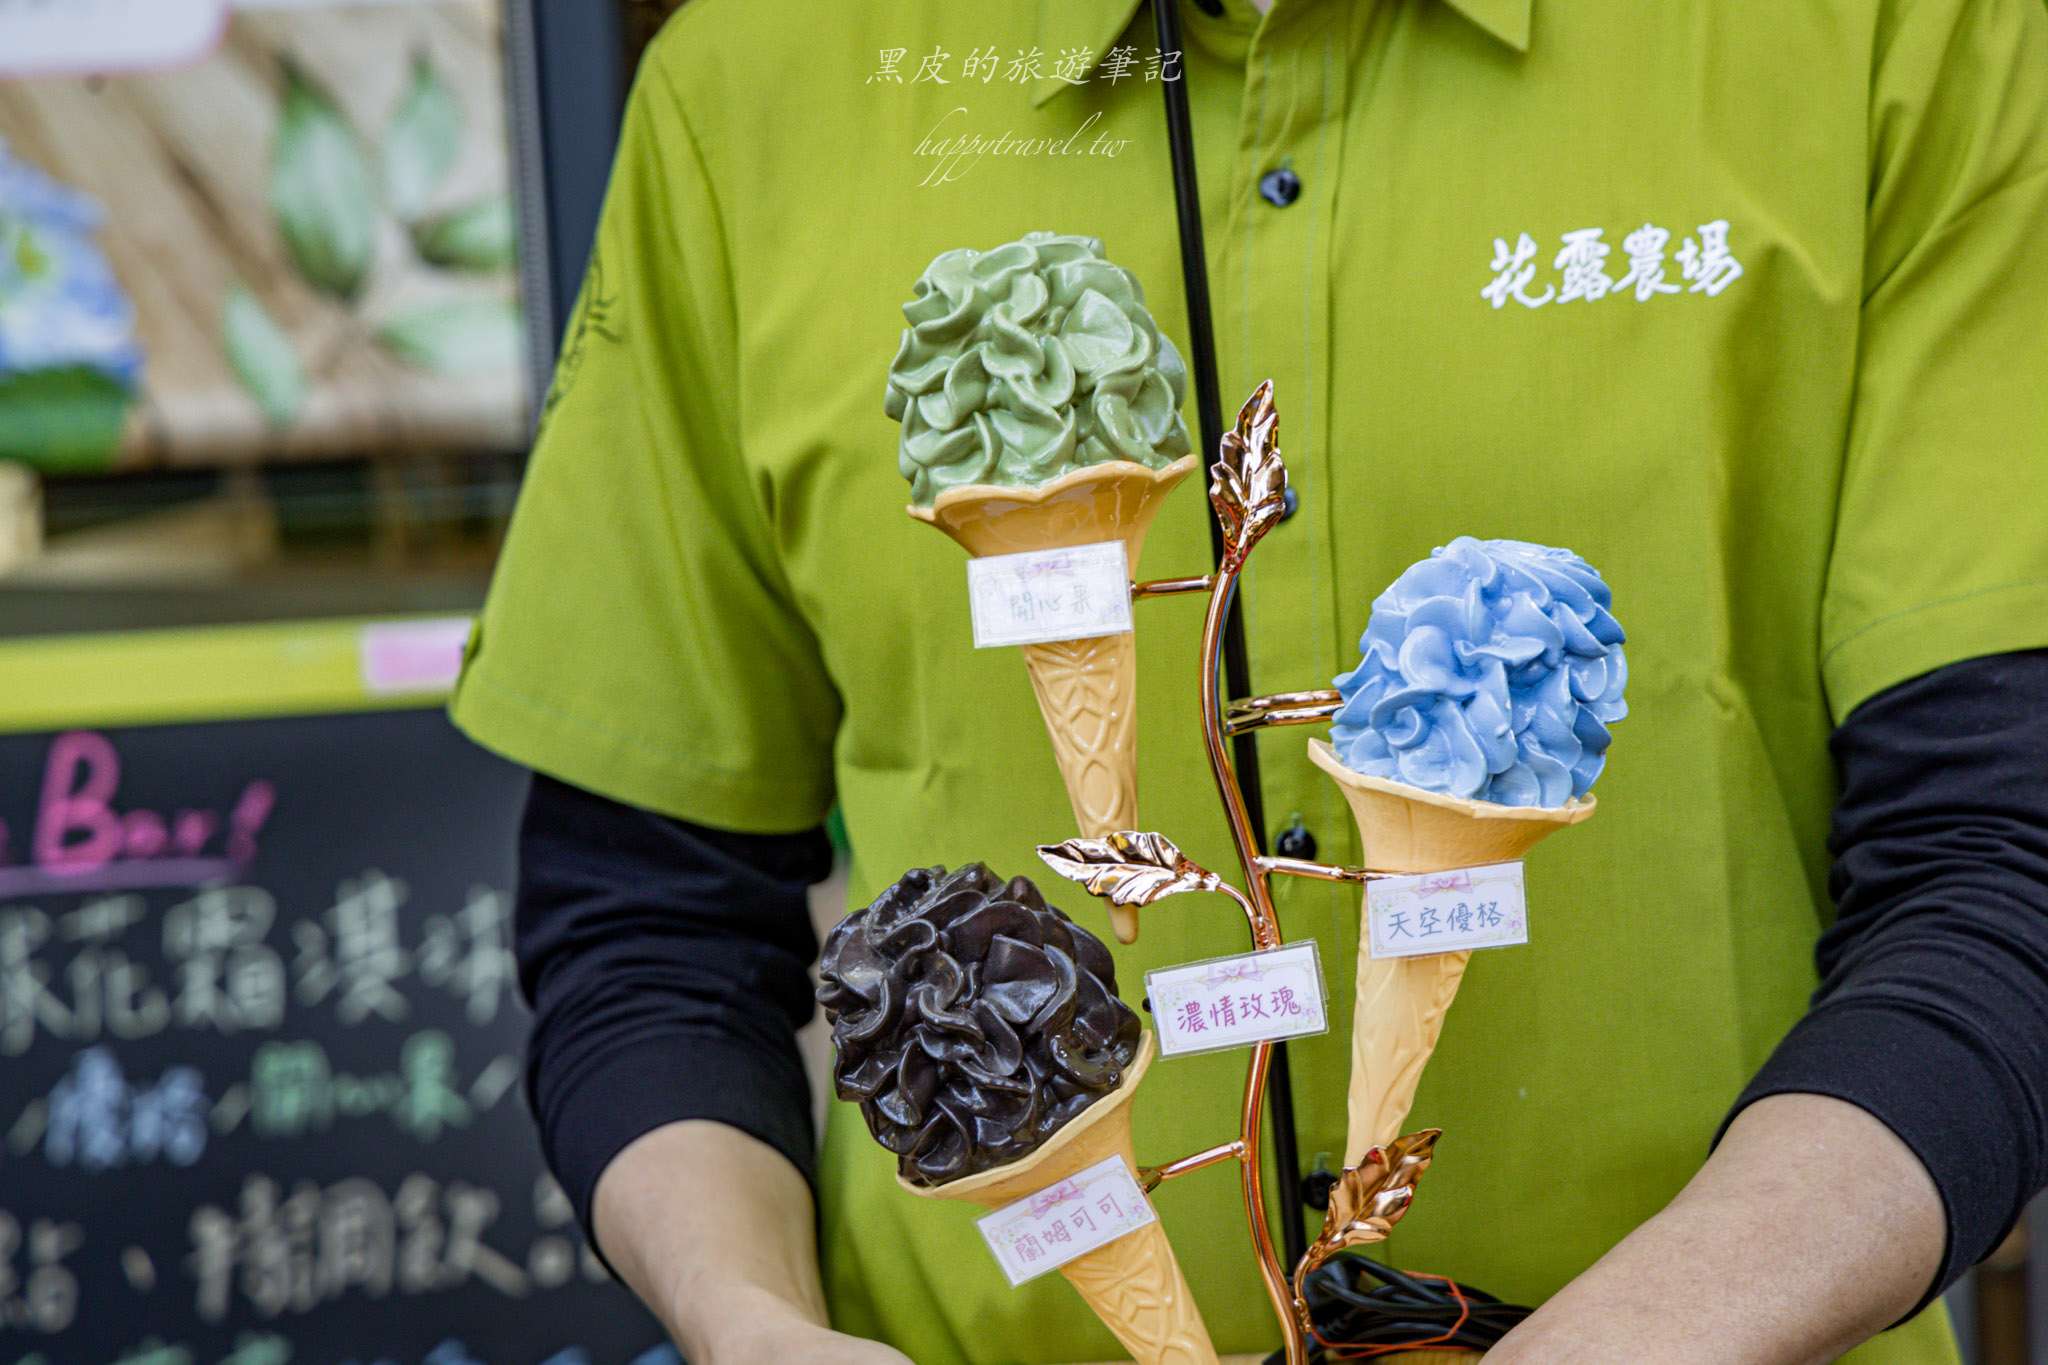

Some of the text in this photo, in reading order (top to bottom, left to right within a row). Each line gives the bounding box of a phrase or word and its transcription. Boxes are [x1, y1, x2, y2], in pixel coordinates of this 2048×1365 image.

[1480, 220, 1743, 309] 花露農場
[1010, 584, 1095, 620] 開心果
[1388, 901, 1506, 940] 天空優格
[1177, 986, 1301, 1034] 濃情玫瑰
[1014, 1193, 1124, 1263] 蘭姆可可
